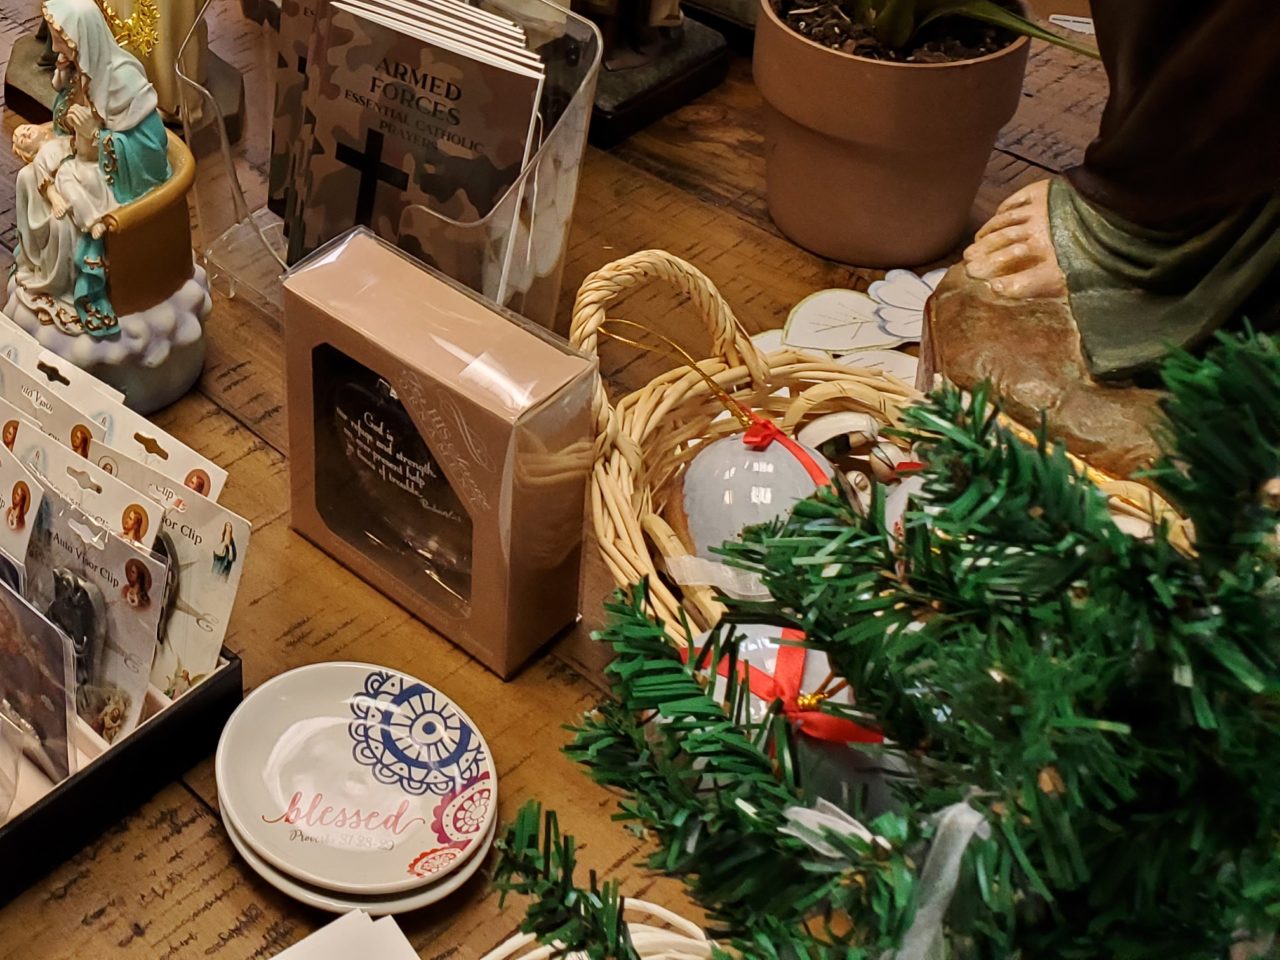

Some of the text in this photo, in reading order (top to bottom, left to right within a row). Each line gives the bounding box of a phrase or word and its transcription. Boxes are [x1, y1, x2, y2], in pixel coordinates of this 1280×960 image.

[374, 57, 462, 101] ARMED
[370, 77, 460, 126] FORCES
[345, 89, 485, 154] ESSENTIAL CATHOLIC
[379, 120, 438, 152] PRAYERS
[363, 411, 394, 442] God is
[376, 438, 393, 456] and
[406, 467, 426, 489] help
[180, 525, 203, 545] Clip
[53, 532, 119, 588] Auto Visor Clip
[262, 791, 426, 835] blessed
